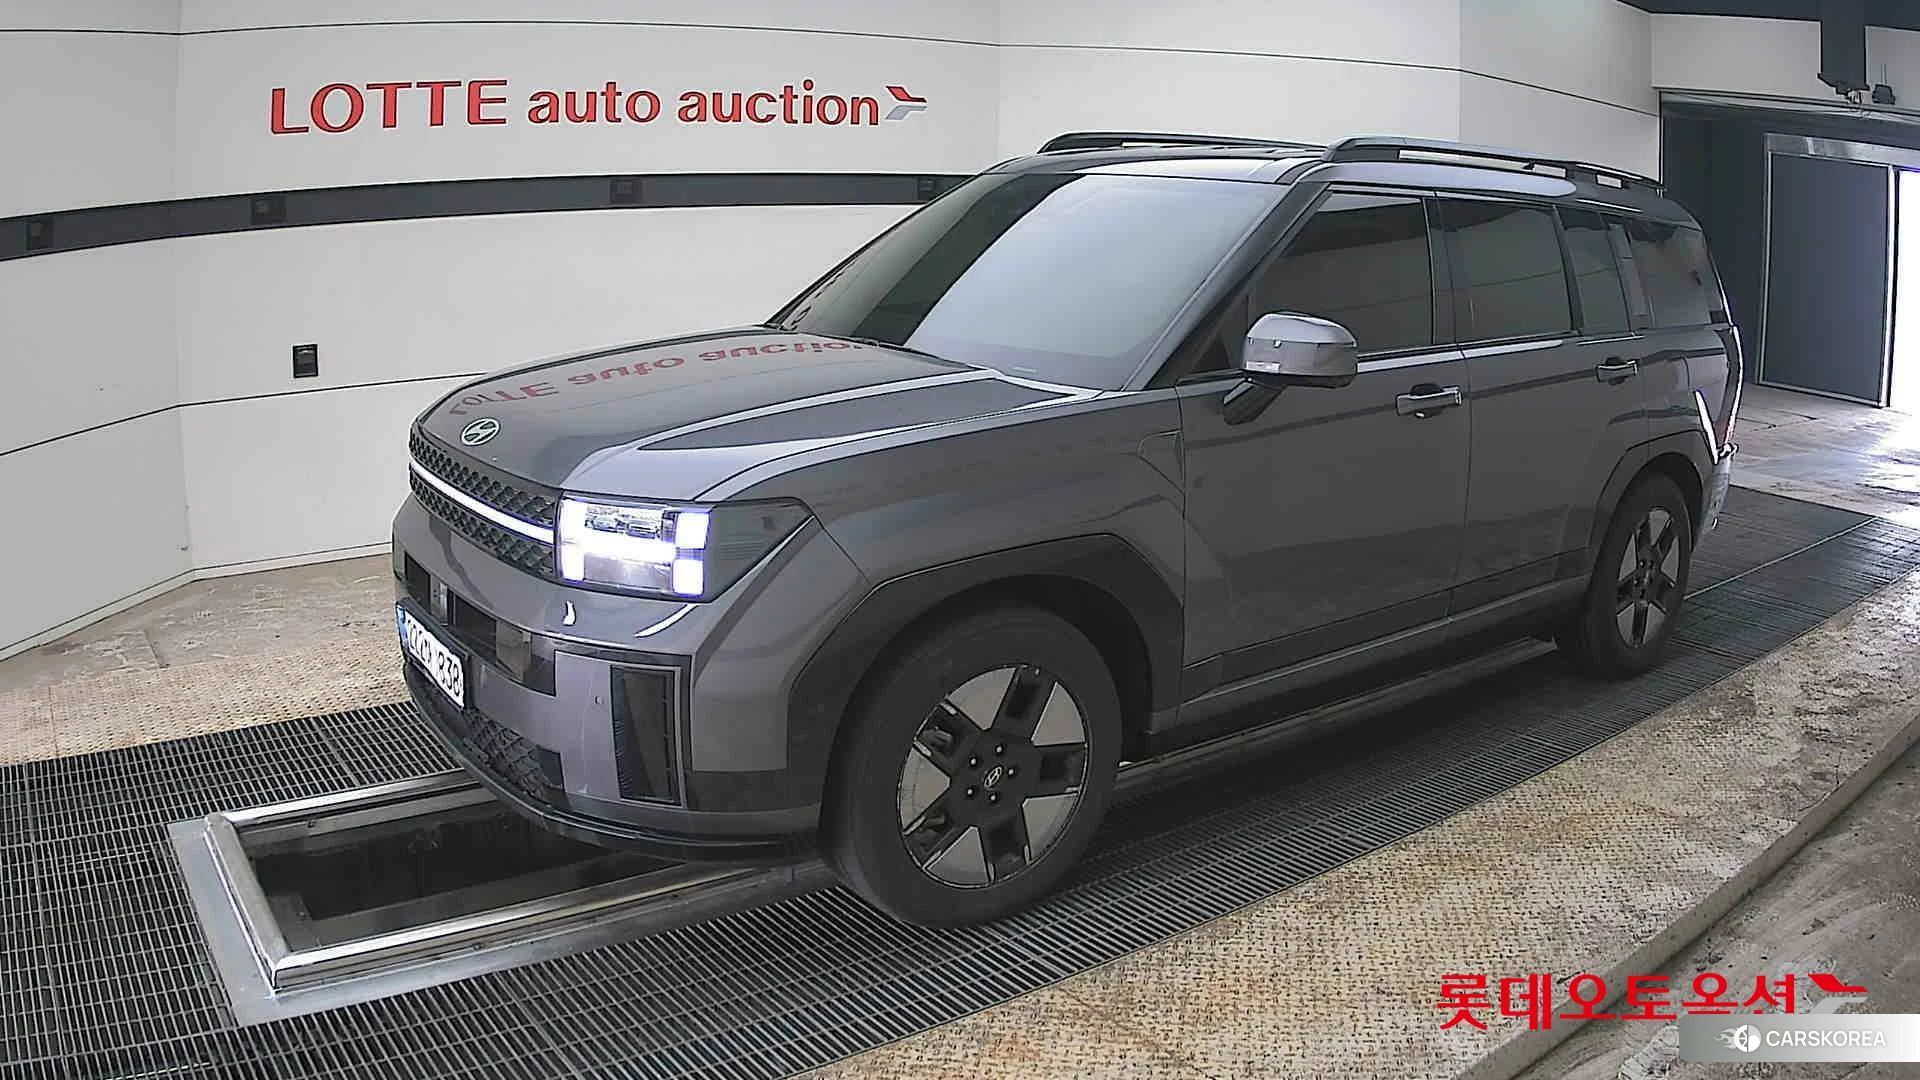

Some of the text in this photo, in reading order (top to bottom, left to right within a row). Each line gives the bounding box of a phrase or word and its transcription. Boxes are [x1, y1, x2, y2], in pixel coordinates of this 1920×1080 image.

[270, 79, 880, 135] LOTTE auto auction
